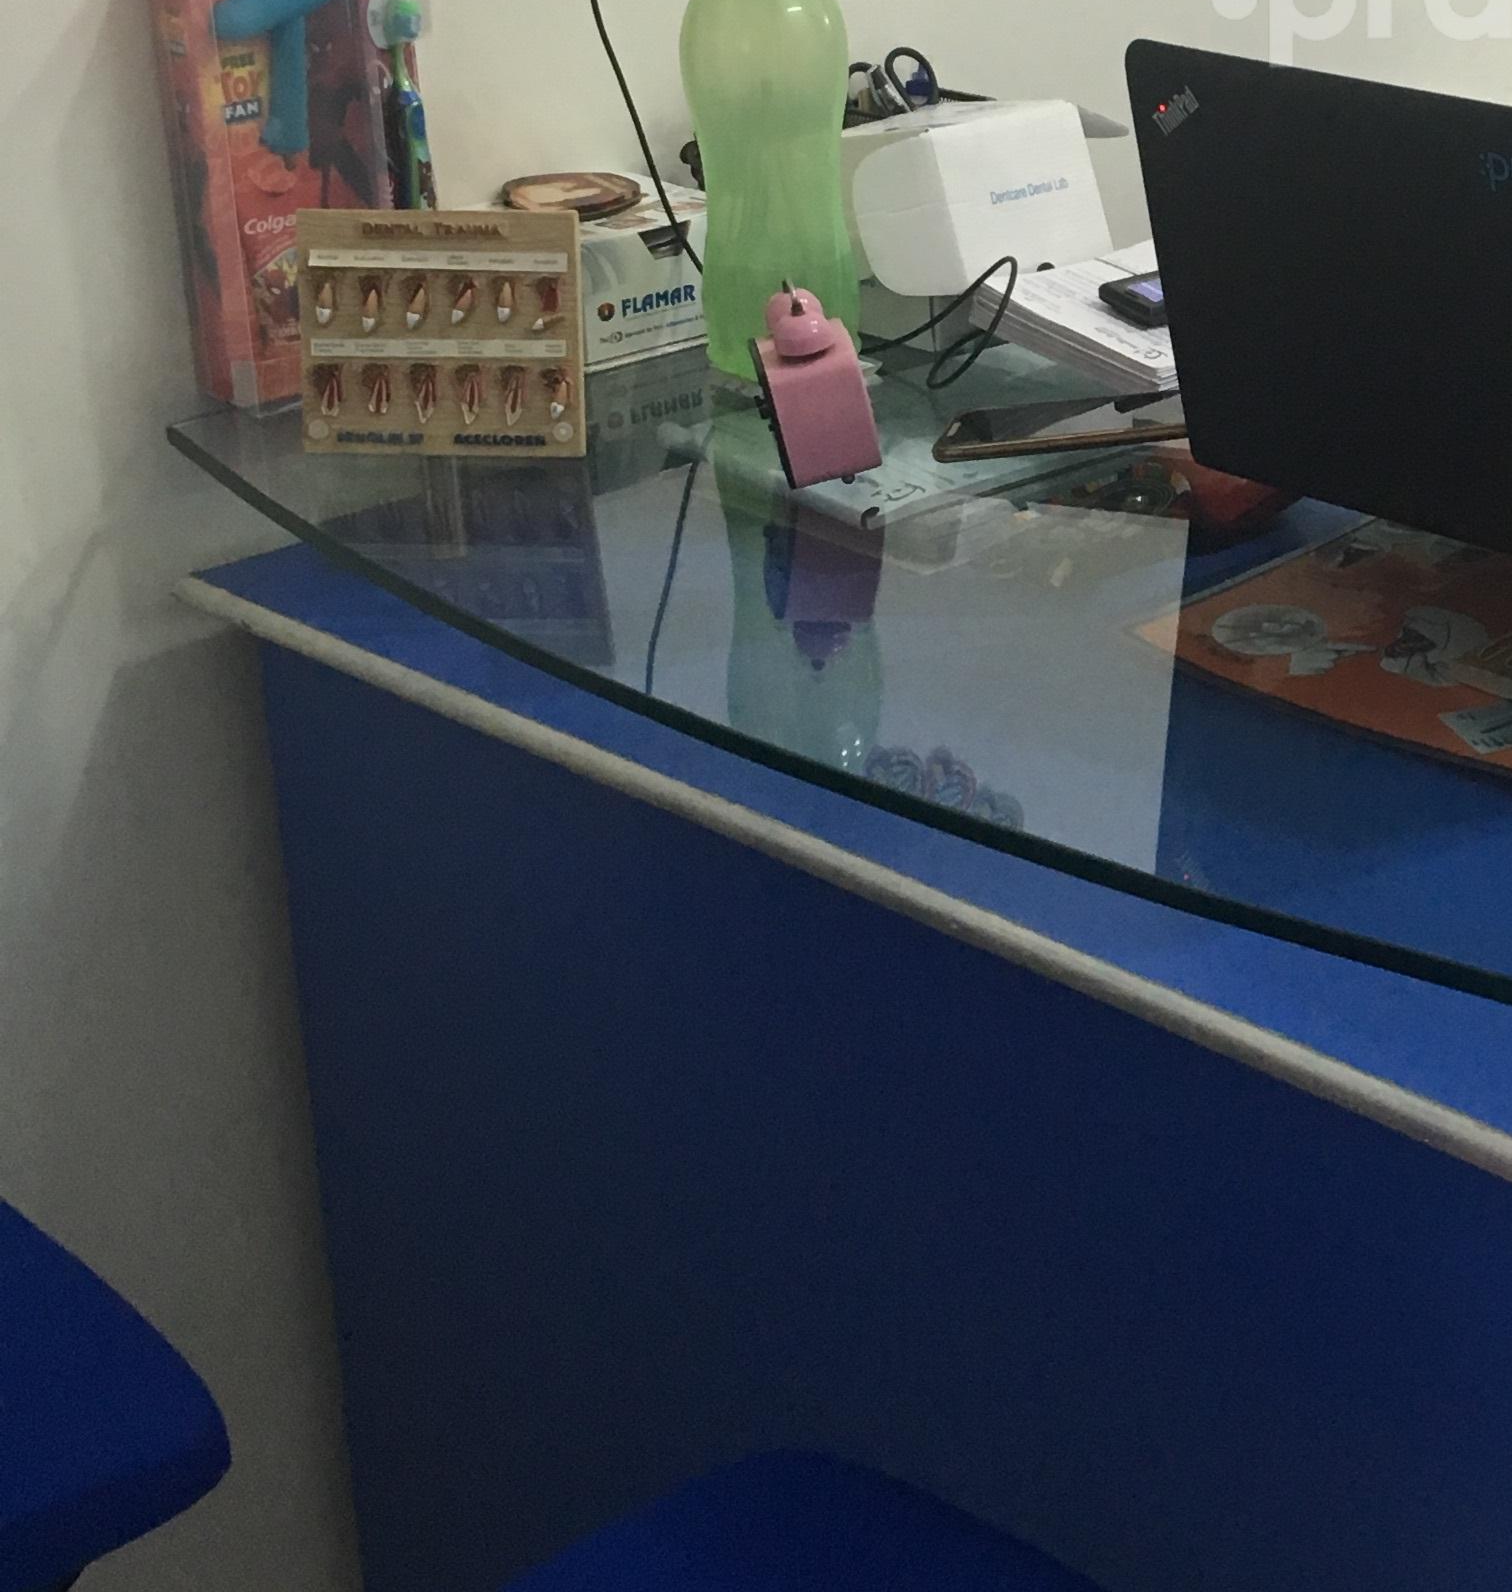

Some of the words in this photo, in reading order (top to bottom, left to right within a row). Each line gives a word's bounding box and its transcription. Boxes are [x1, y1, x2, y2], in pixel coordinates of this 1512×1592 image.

[224, 100, 260, 121] FAN
[1152, 85, 1199, 137] ThinkPad
[361, 221, 423, 236] DENTAL
[433, 221, 504, 237] TRAUMA
[622, 284, 696, 319] FLAMAR
